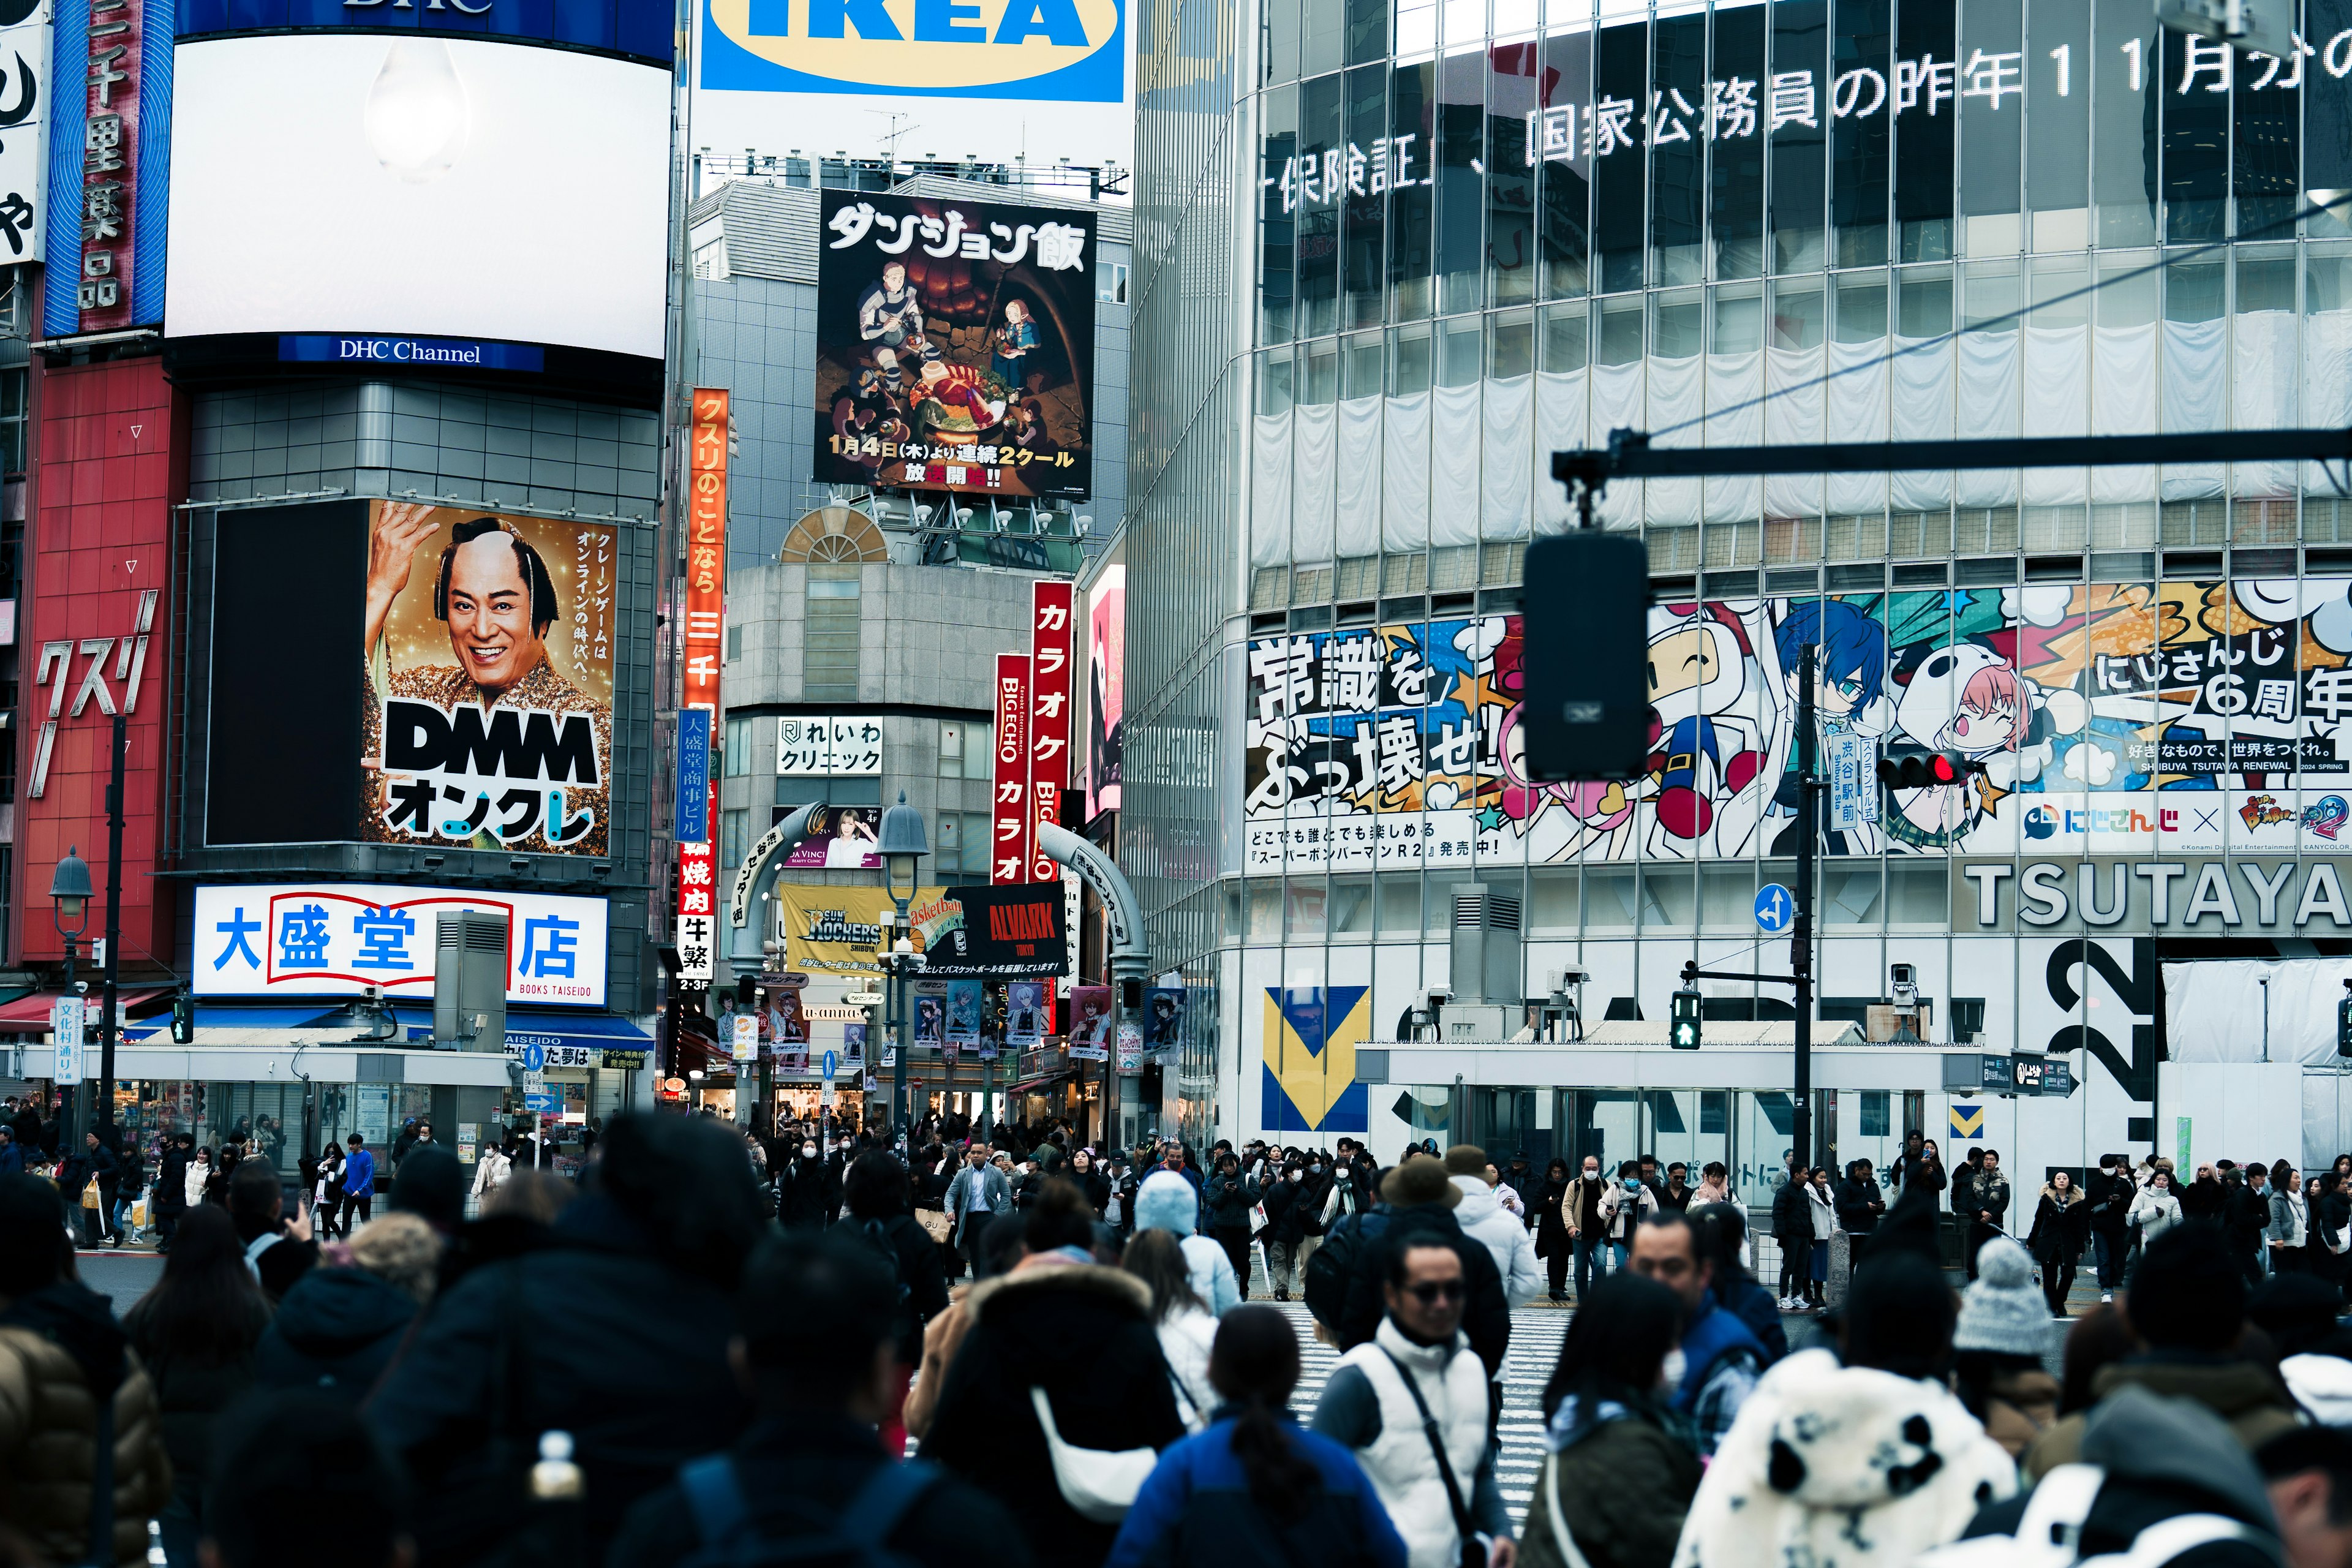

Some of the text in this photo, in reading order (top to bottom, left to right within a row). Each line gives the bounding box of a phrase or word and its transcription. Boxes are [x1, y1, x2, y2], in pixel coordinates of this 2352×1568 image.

[748, 0, 1090, 47] IKEA
[828, 202, 1086, 273] ダンジョン飯
[340, 341, 480, 363] DHC Channel
[693, 399, 722, 594] クスリのことなら
[905, 462, 1001, 488] 放送開始!!
[573, 532, 591, 681] オンラインの時代へ。
[594, 533, 610, 659] クレーンゲームは
[1033, 604, 1067, 761] カラオケ
[1250, 635, 1436, 725] 常識を
[2097, 627, 2285, 690] にじさんじ
[1000, 677, 1019, 763] BIG ECHO
[2205, 668, 2352, 720] 6周年
[385, 700, 598, 784] DMM
[782, 750, 880, 771] クリニック
[807, 723, 880, 743] れいわ
[1246, 706, 1504, 816] ぶっ壊せ!
[2128, 742, 2330, 760] 好きなもので、世界をつくれ。
[682, 718, 703, 835] 大盛堂商事ビル
[1842, 740, 1854, 822] 渋谷駅前
[1863, 741, 1874, 818] スクランブル式
[2141, 762, 2187, 772] SHIBUYA
[2192, 762, 2239, 771] TSUTAYA
[2243, 761, 2291, 771] RENEWAL
[387, 779, 590, 840] オンクレ
[867, 813, 877, 823] 4F
[1036, 782, 1055, 820] BIG
[2065, 808, 2178, 834] にじさんじ
[995, 781, 1023, 880] カラオ
[1251, 822, 1434, 846] どこでも誰とでも楽しめる
[733, 832, 777, 924] 渋谷センター街
[1077, 853, 1124, 940] 渋谷センター街
[1964, 862, 2352, 925] TSUTAYA
[213, 903, 579, 979] 大盛堂店
[683, 918, 708, 969] 牛繁
[824, 910, 845, 921] SUN
[925, 914, 965, 952] STREET
[989, 902, 1055, 941] ALVARK
[850, 944, 875, 953] SHIBUYA
[1016, 944, 1035, 957] TOKYO
[520, 984, 590, 997] BOOKS TAISEIDO
[59, 1004, 72, 1071] 文化村通り
[610, 1060, 639, 1069] 発売中!!
